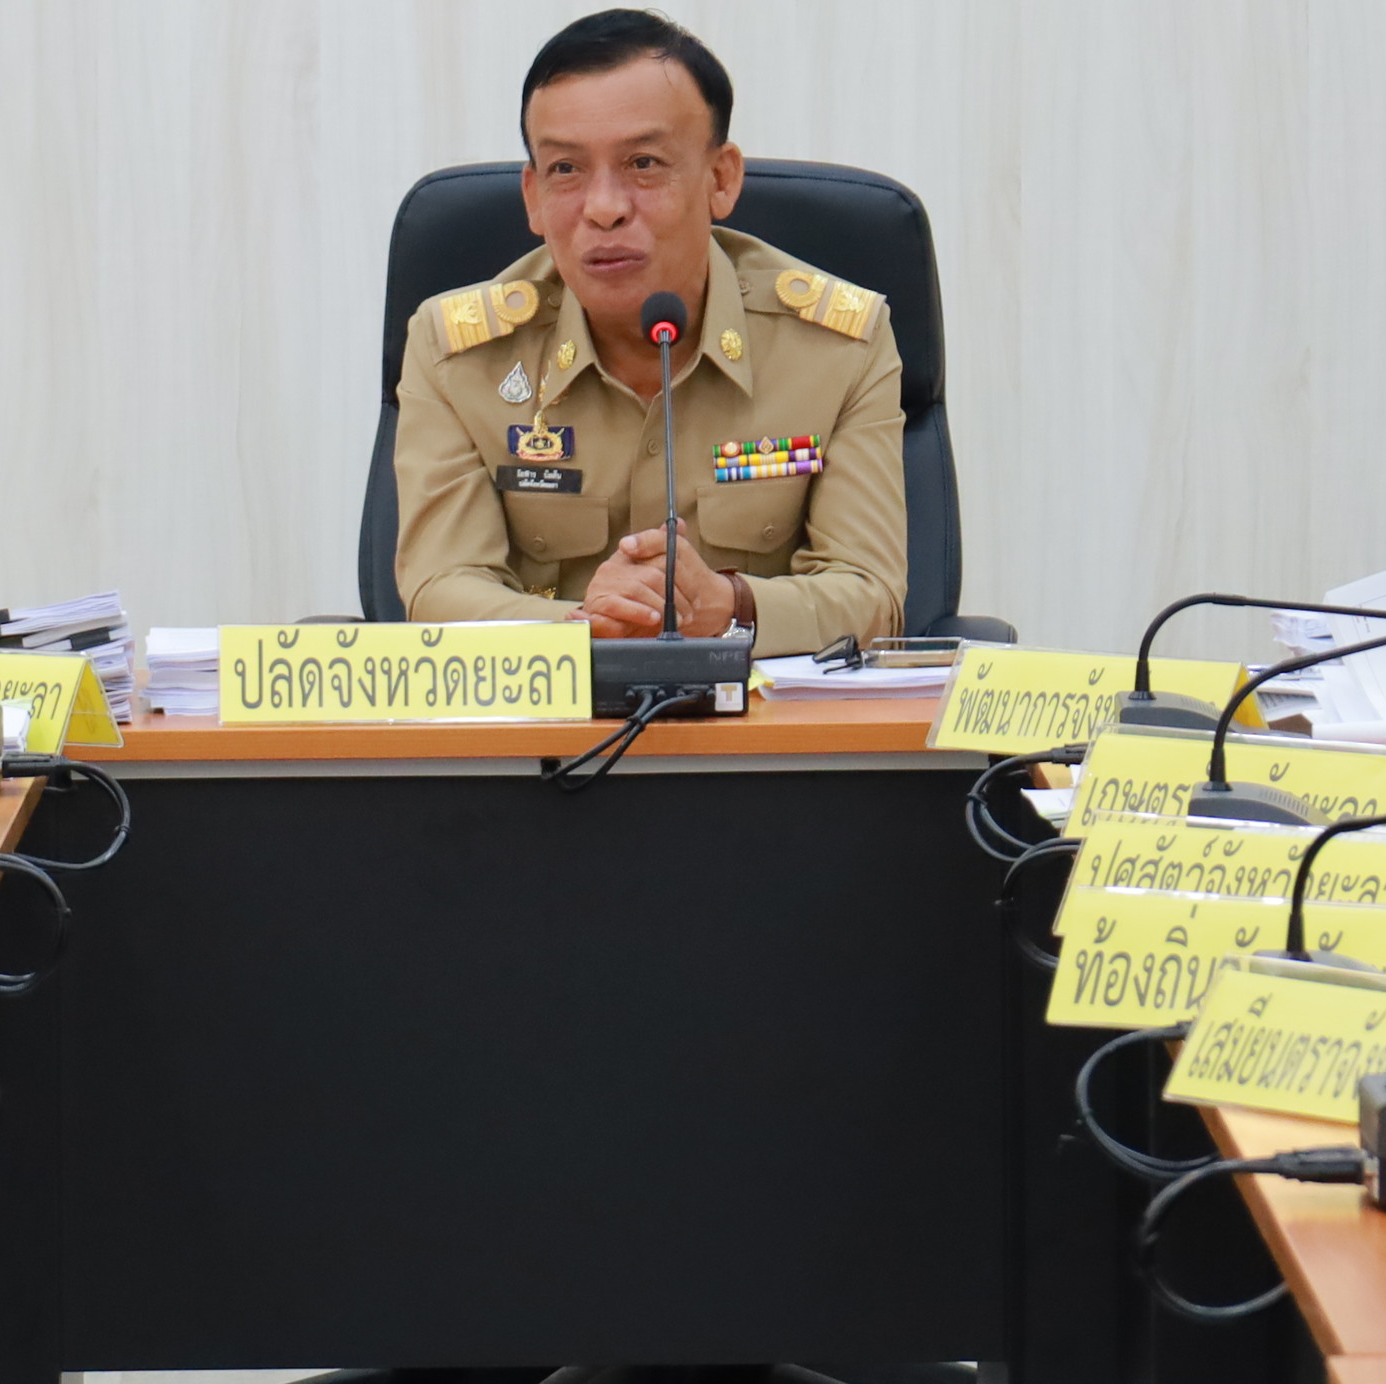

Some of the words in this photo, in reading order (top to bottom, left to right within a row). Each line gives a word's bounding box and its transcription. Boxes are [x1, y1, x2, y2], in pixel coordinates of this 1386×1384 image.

[234, 627, 578, 710] ปลัดจังหวัดยะลา
